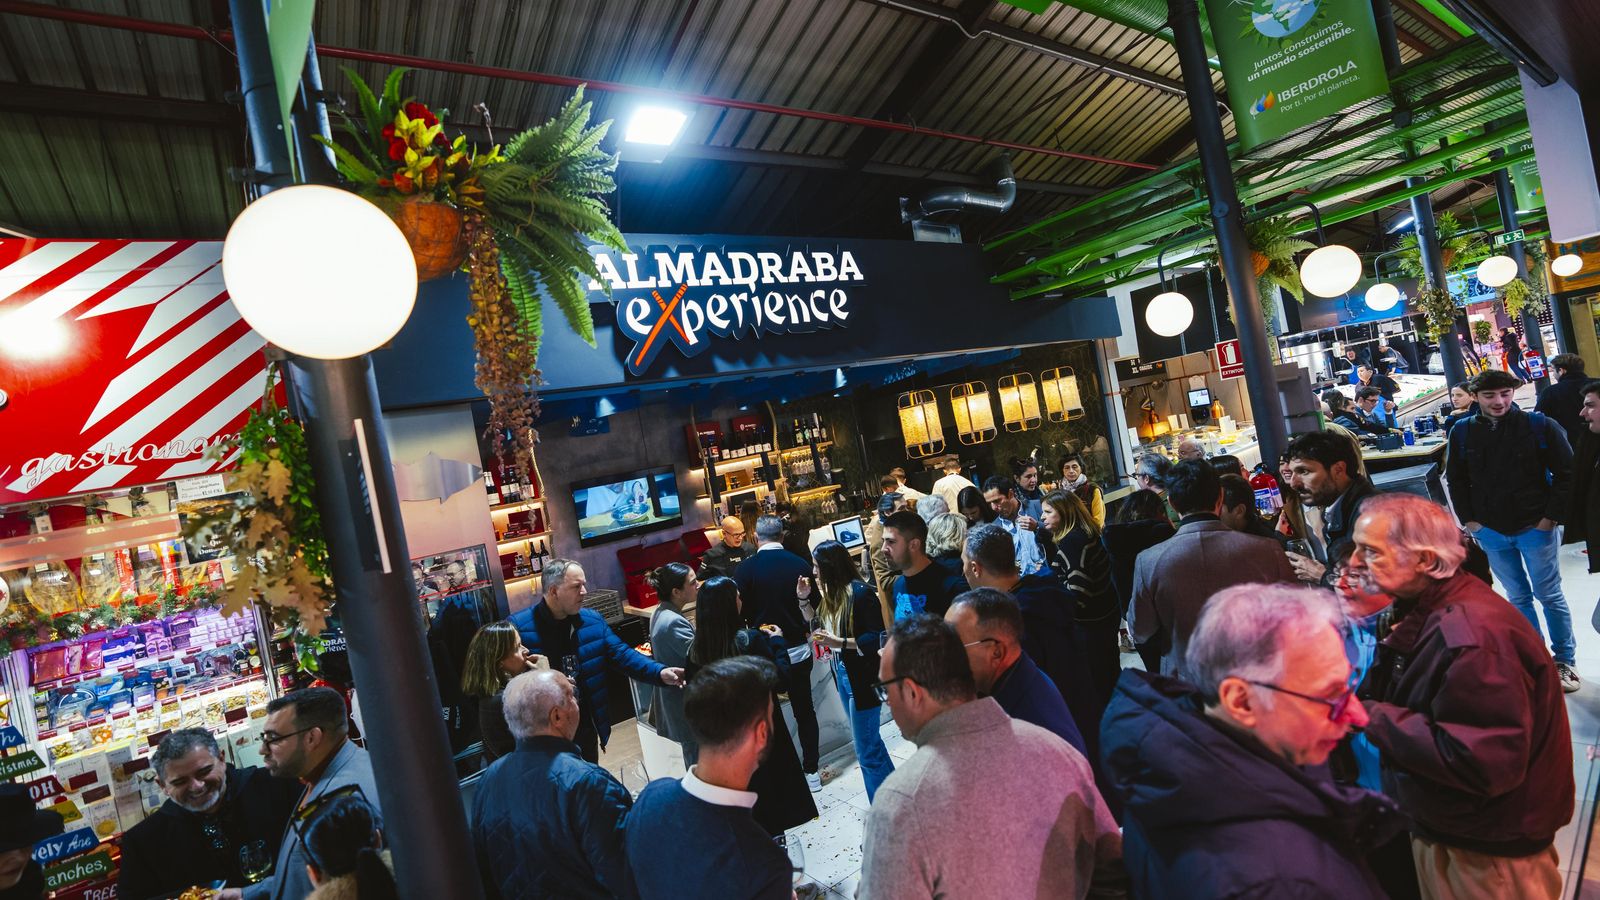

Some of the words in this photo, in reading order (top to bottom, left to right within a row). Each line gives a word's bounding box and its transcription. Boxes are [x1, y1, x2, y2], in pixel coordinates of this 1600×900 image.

[1247, 72, 1260, 82] un
[1261, 55, 1296, 77] mundo
[1298, 26, 1355, 58] sostenible.
[1253, 52, 1282, 71] Juntos
[1284, 20, 1344, 54] construimos
[1277, 60, 1357, 102] IBERDROLA
[1280, 102, 1294, 113] Por
[1304, 92, 1317, 103] Por
[1318, 86, 1326, 97] el
[1327, 74, 1360, 94] planeta.
[588, 251, 864, 293] ALMADRABA
[29, 780, 56, 800] OH
